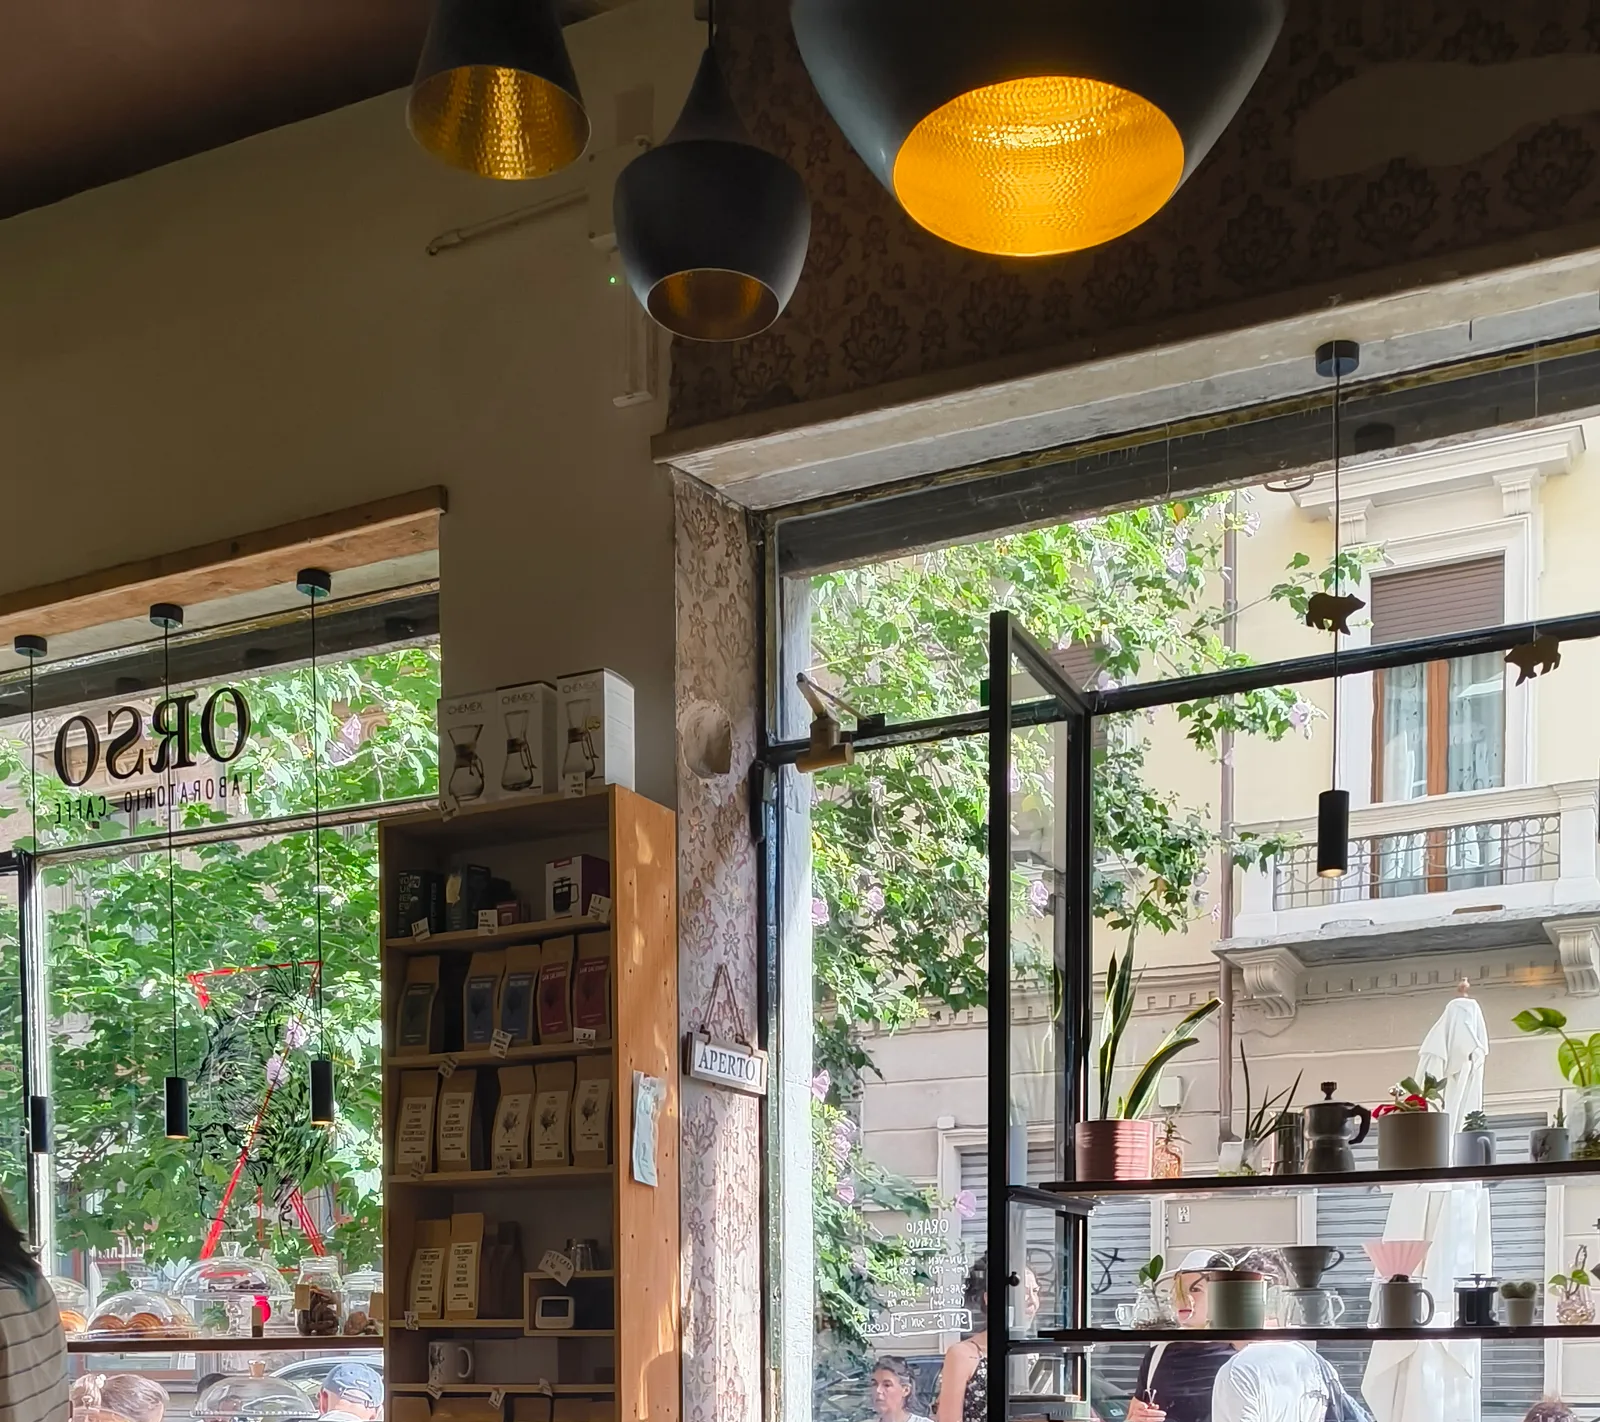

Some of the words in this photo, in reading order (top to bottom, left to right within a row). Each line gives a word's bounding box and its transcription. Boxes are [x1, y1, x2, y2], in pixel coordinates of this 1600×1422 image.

[501, 692, 536, 706] CHEMEX
[447, 700, 483, 715] CHEMEX
[698, 1047, 756, 1081] APERTO
